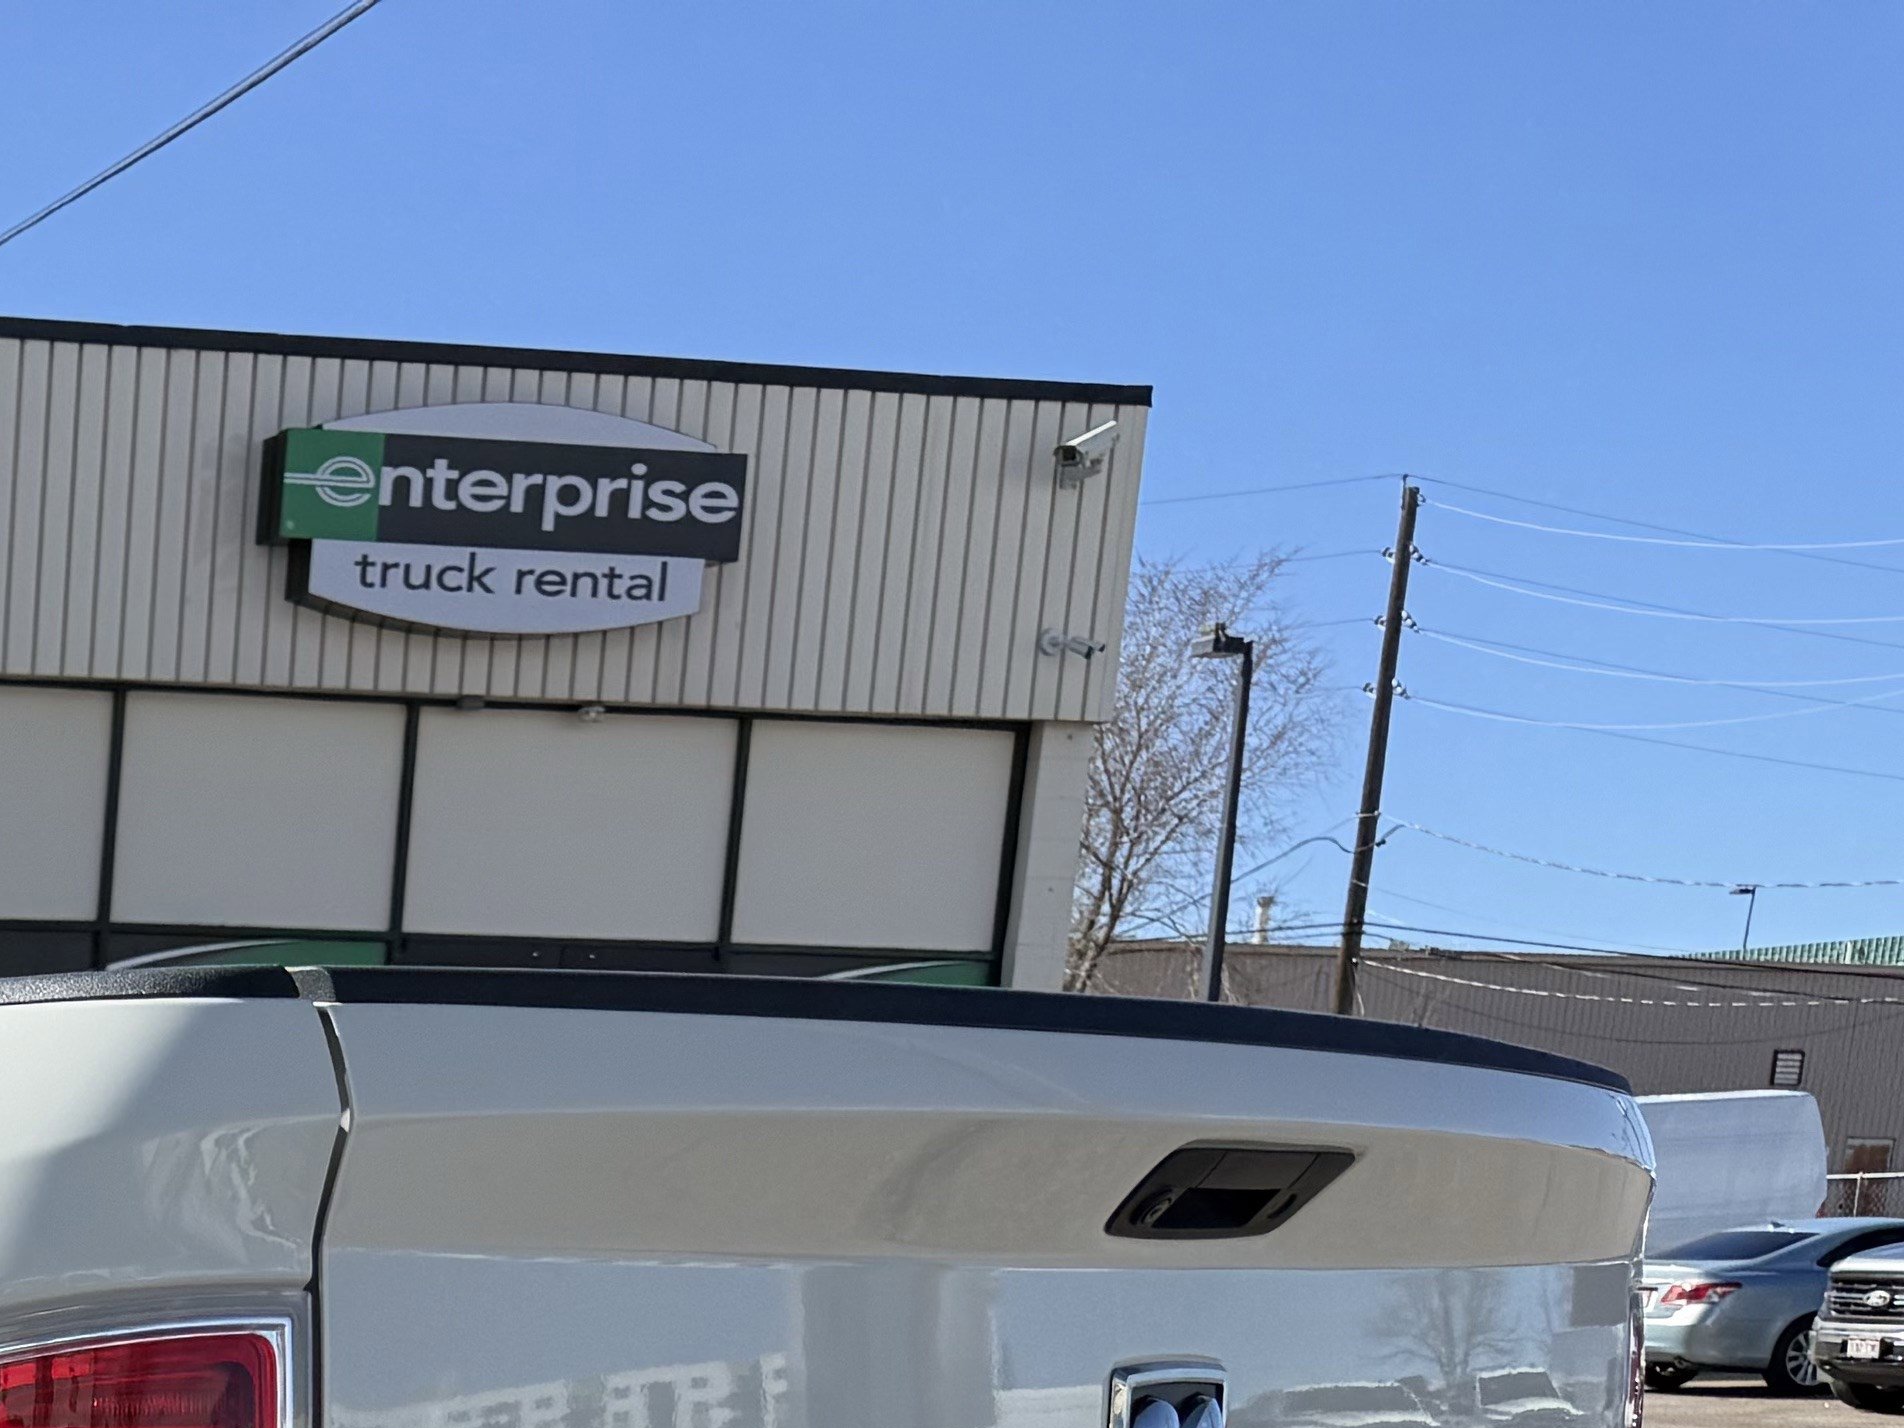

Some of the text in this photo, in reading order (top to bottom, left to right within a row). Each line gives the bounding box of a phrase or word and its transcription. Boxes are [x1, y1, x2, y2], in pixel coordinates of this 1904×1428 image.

[283, 455, 740, 532] enterprise
[353, 551, 668, 602] truck rental
